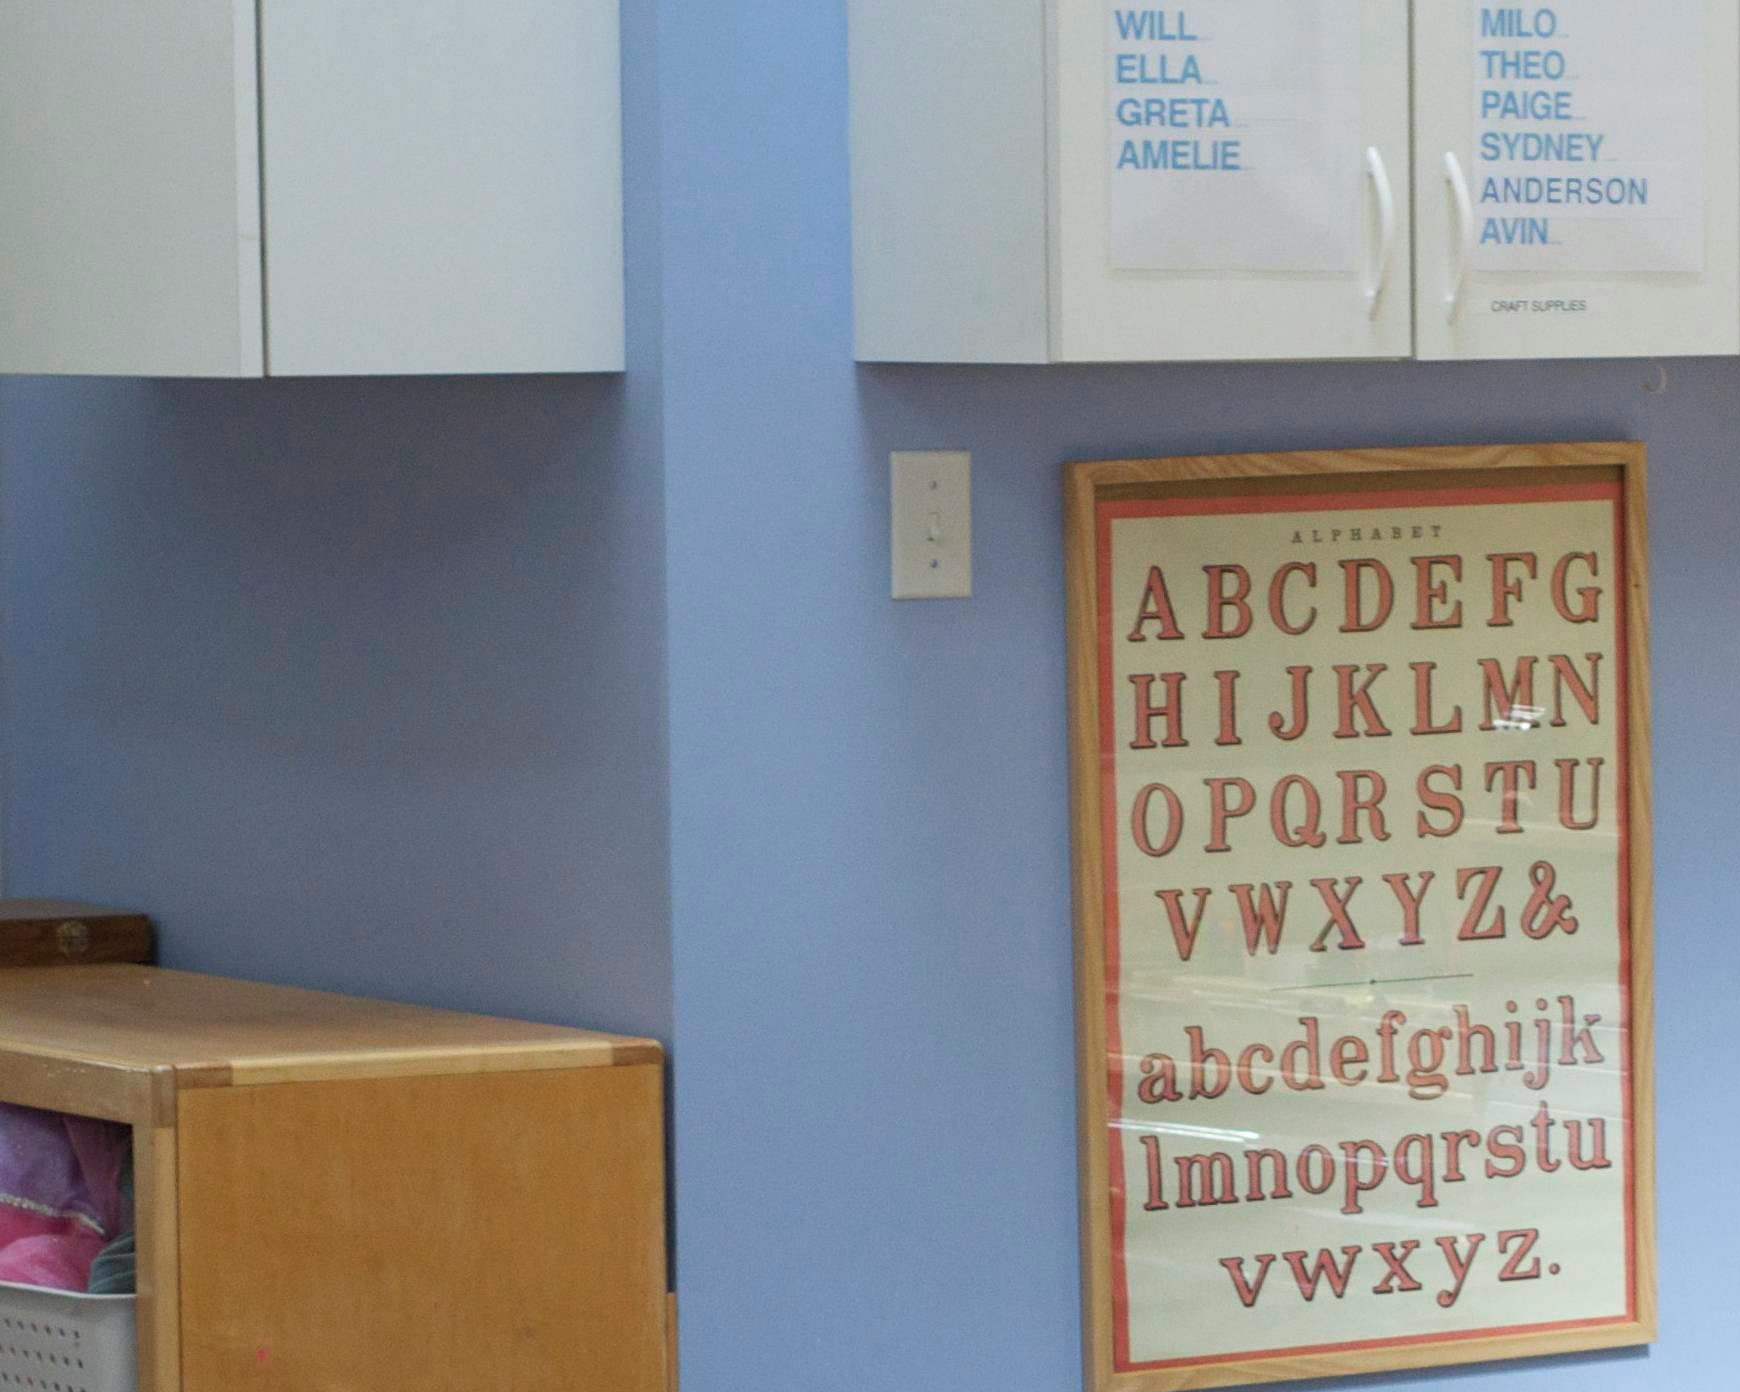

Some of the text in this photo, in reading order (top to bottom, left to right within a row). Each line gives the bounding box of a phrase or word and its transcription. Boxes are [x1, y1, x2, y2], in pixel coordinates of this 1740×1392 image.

[1114, 8, 1199, 43] WILL
[1480, 4, 1558, 40] MILO
[1114, 52, 1203, 86] ELLA
[1480, 47, 1567, 82] THEO
[1115, 95, 1231, 129] GRETA
[1480, 88, 1572, 122] PAIGE
[1116, 137, 1241, 172] AMELIE
[1480, 130, 1604, 163] SYDNEY
[1480, 174, 1649, 206] ANDERSON
[1480, 215, 1549, 246] AVIN
[1490, 299, 1587, 313] CRAFT SUPPLIES
[1291, 524, 1442, 544] ALPHABET
